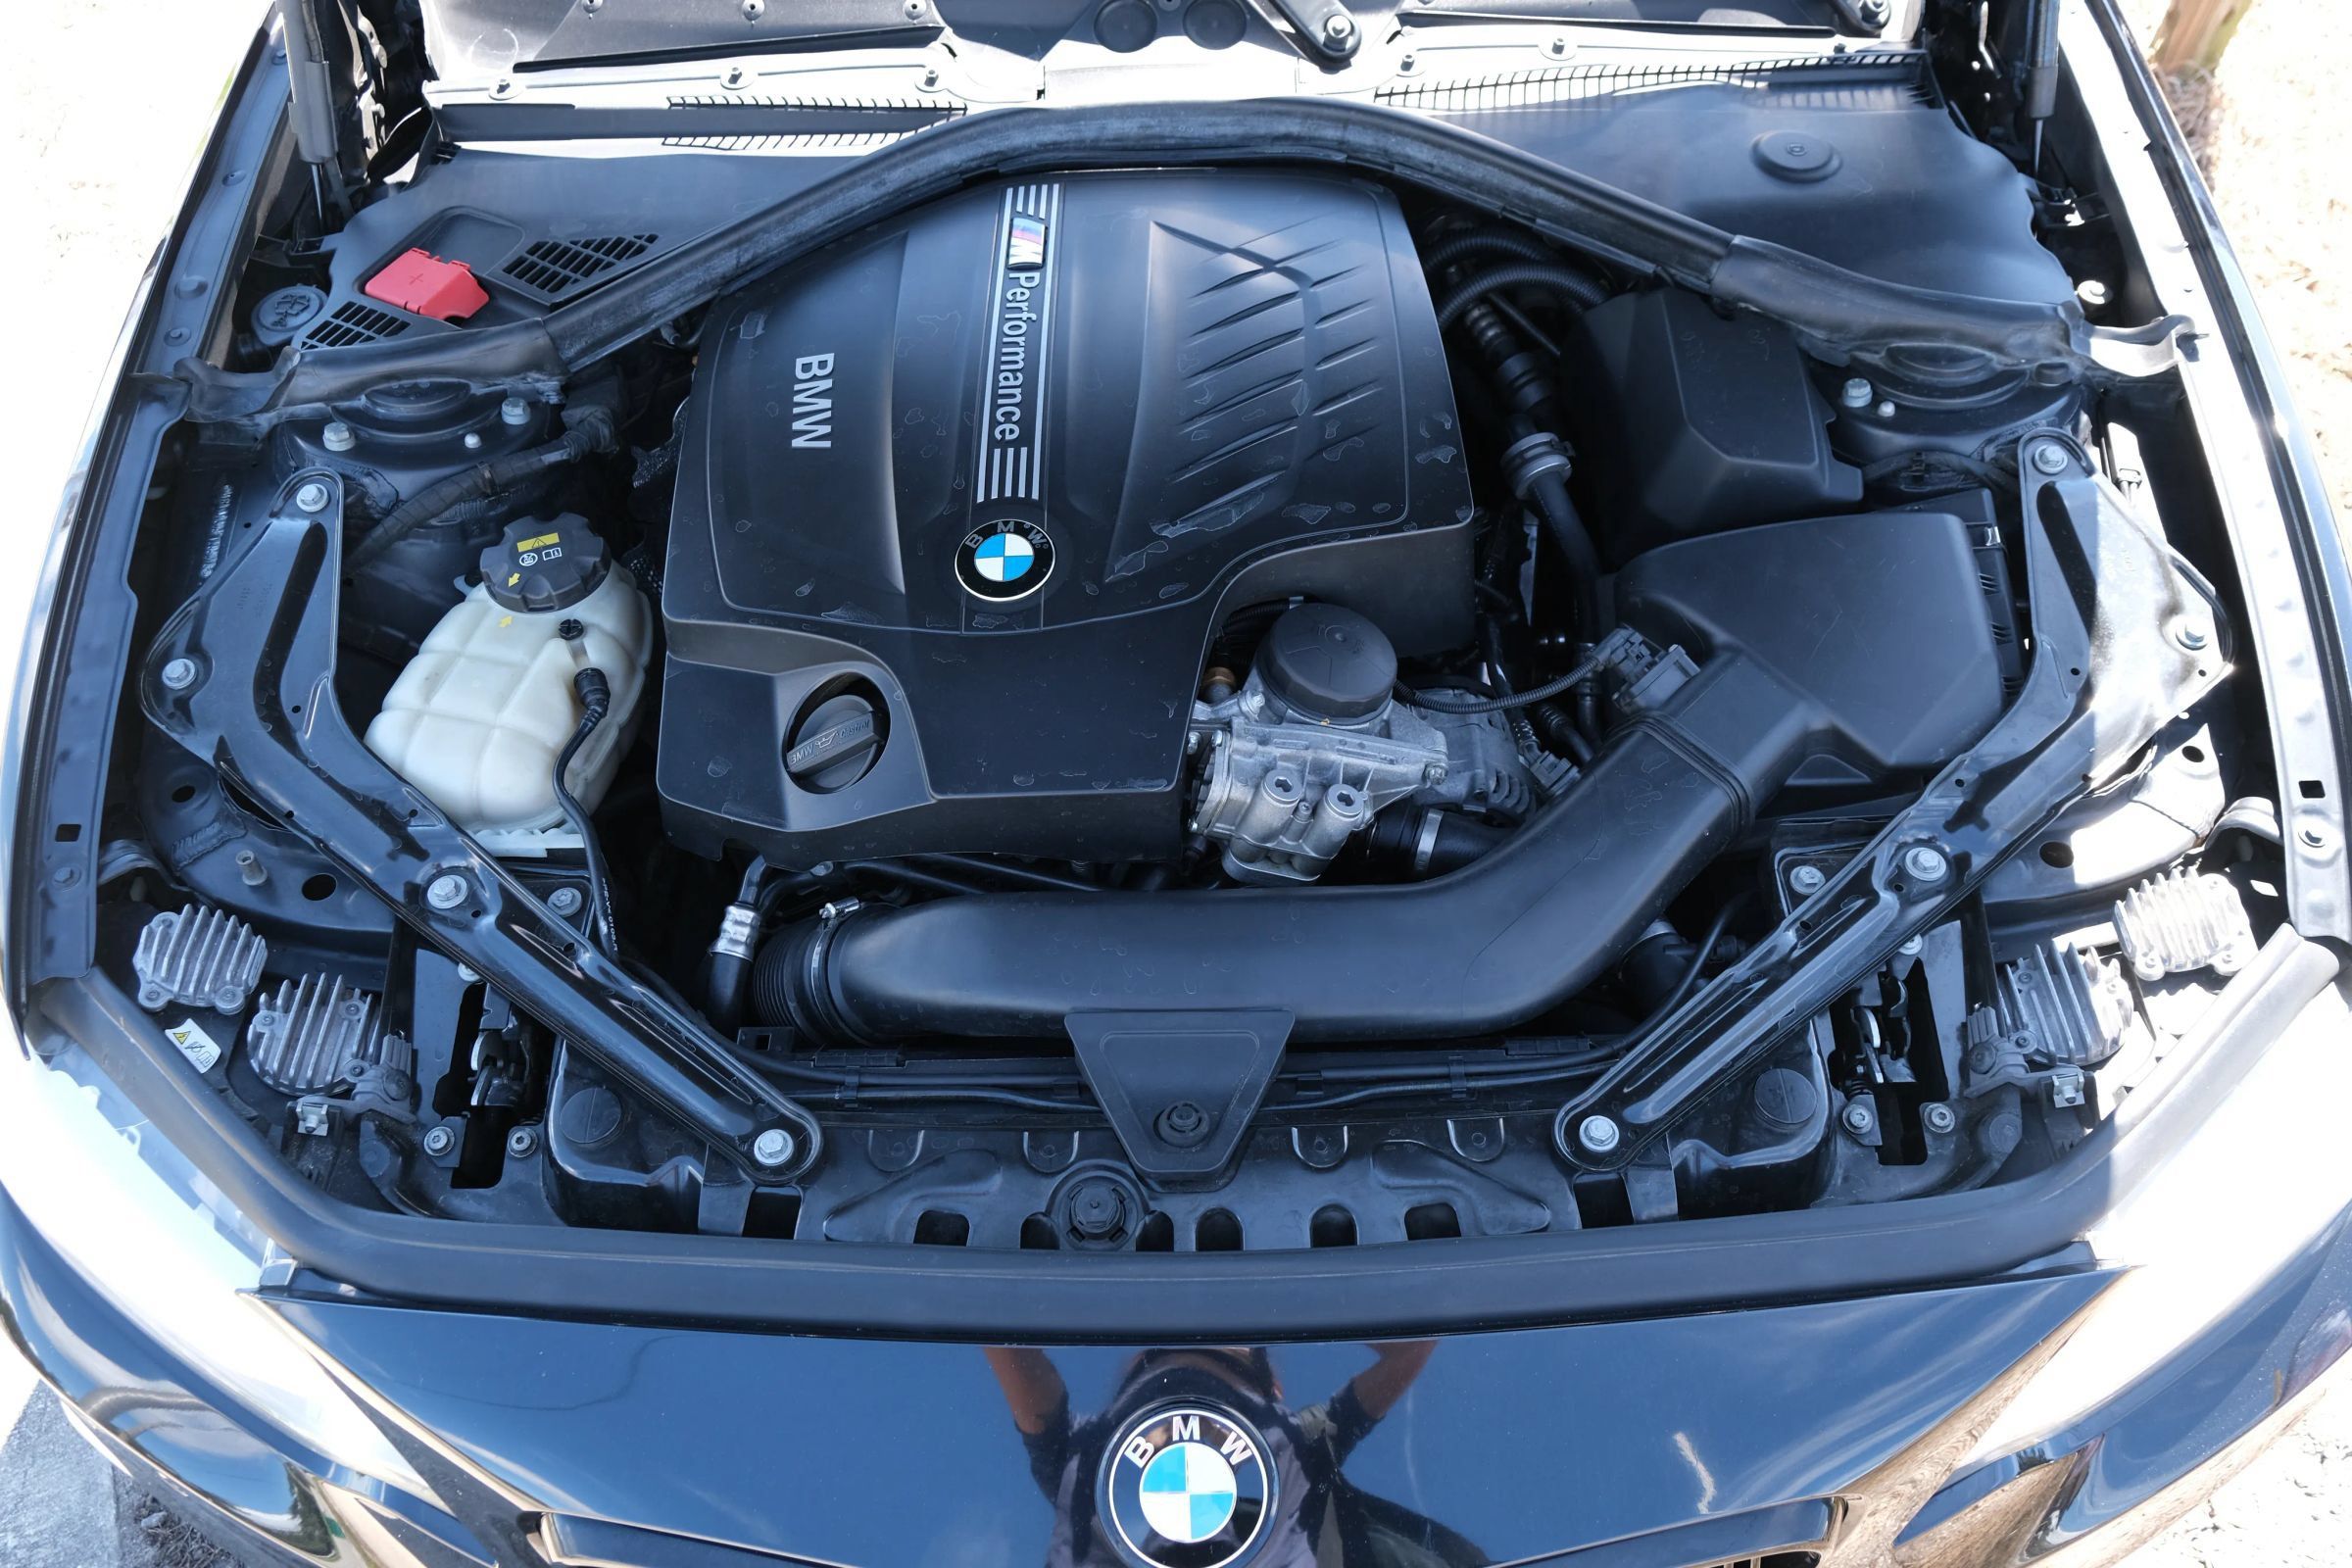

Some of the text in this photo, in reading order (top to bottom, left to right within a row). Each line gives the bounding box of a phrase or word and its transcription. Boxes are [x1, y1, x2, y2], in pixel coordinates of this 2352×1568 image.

[994, 272, 1041, 441] Performance
[791, 353, 835, 448] BMW
[965, 520, 1048, 549] BMW
[1124, 1415, 1252, 1469] BMW
